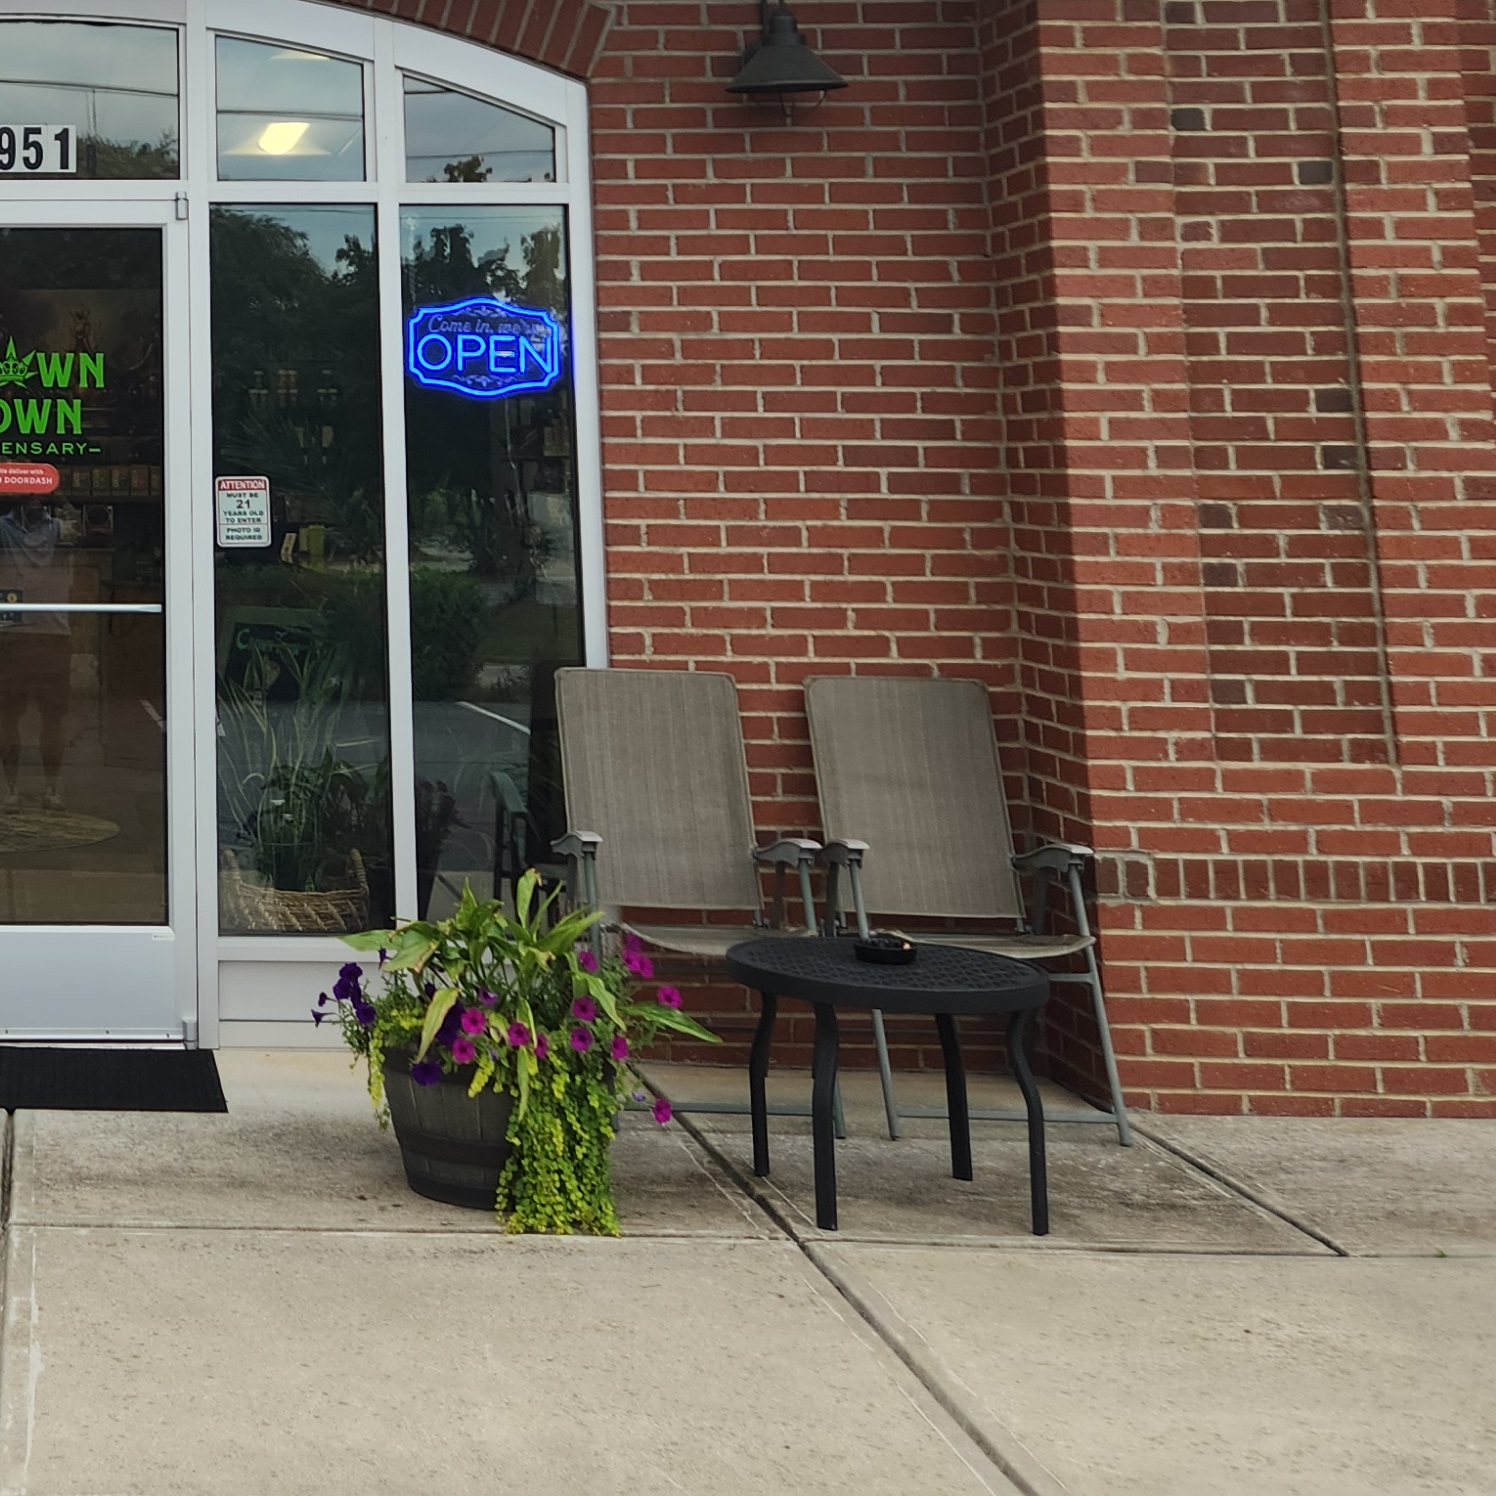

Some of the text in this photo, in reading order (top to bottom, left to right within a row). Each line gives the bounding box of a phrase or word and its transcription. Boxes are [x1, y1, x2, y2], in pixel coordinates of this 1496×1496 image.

[428, 313, 472, 333] Come
[417, 333, 552, 374] OPEN
[4, 476, 53, 484] DOORDASH
[220, 480, 266, 490] ATTENTION
[236, 499, 251, 509] 21
